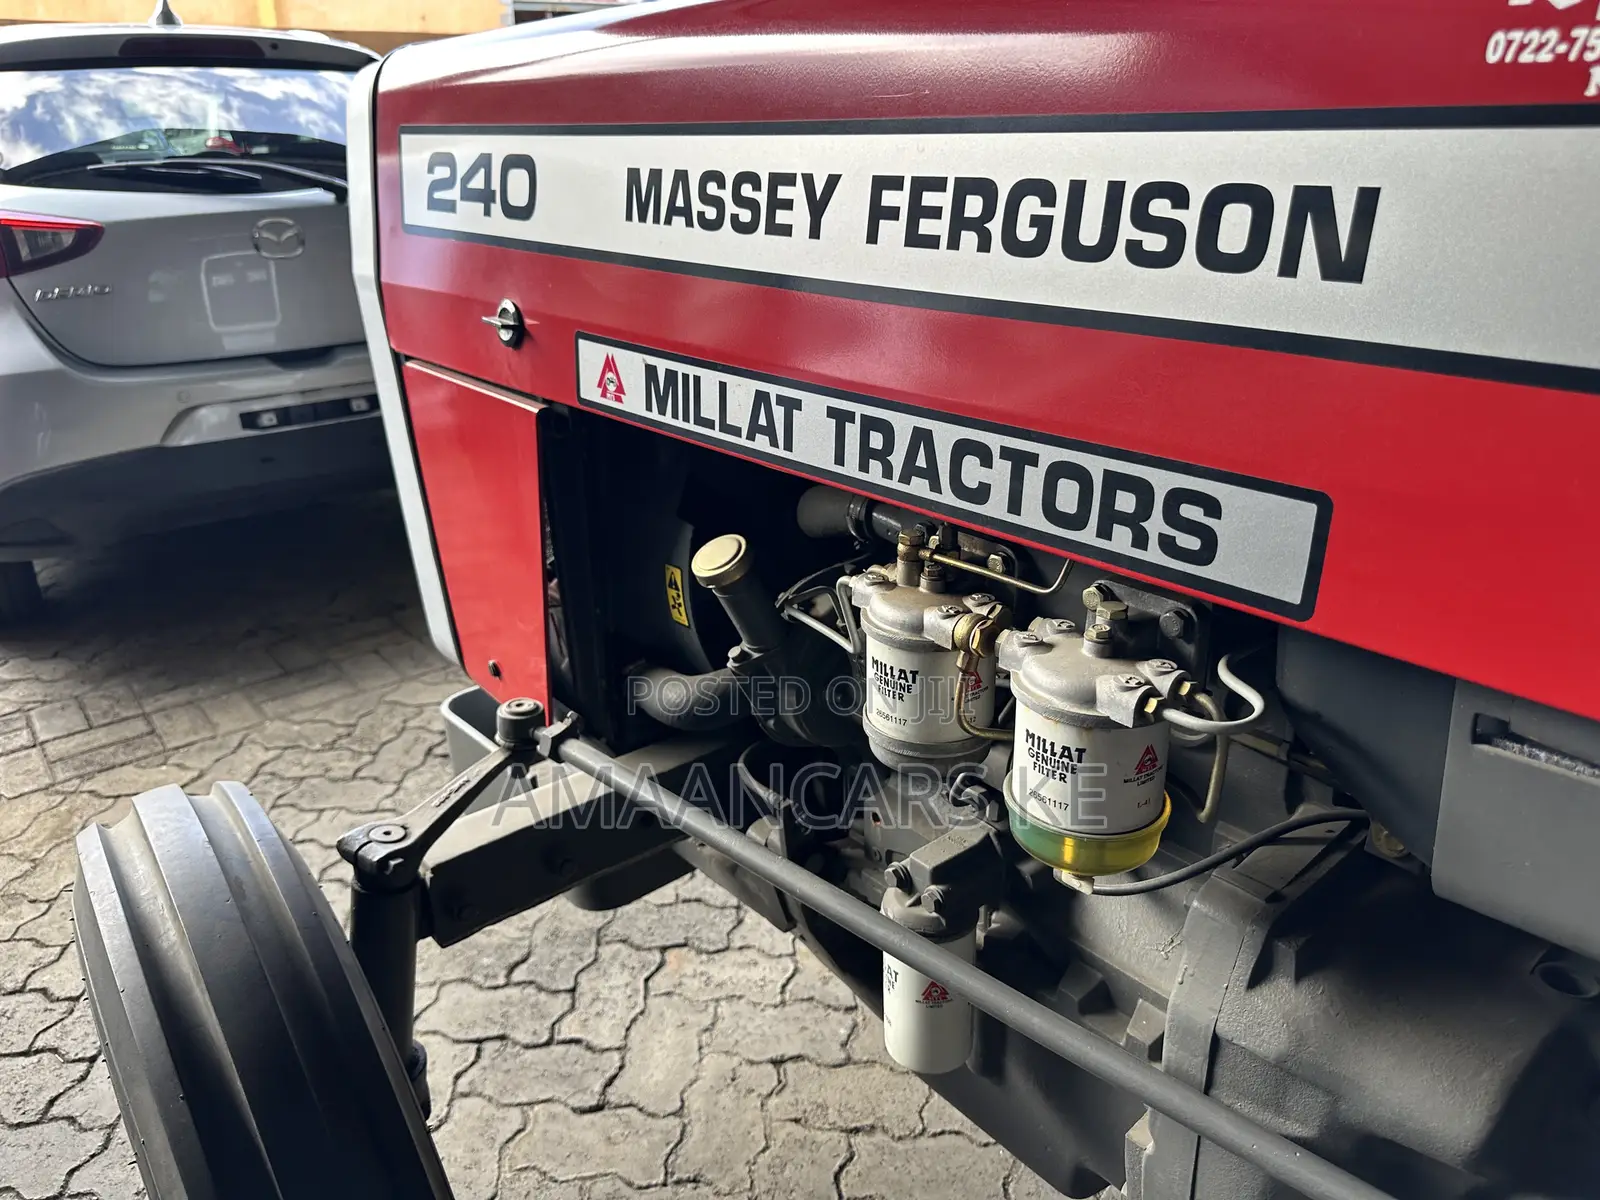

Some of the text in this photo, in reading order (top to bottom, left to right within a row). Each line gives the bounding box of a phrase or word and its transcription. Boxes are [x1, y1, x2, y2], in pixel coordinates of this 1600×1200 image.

[427, 151, 1381, 284] 240 MASSEY FERGUSON
[644, 363, 1222, 566] MILLAT TRACTORS
[871, 656, 919, 684] MILLAT
[874, 672, 913, 694] GENUINE
[878, 684, 905, 702] FILTER
[1025, 728, 1087, 764] MILLAT
[1027, 746, 1078, 775] GENUINE
[1033, 761, 1068, 784] FILTER
